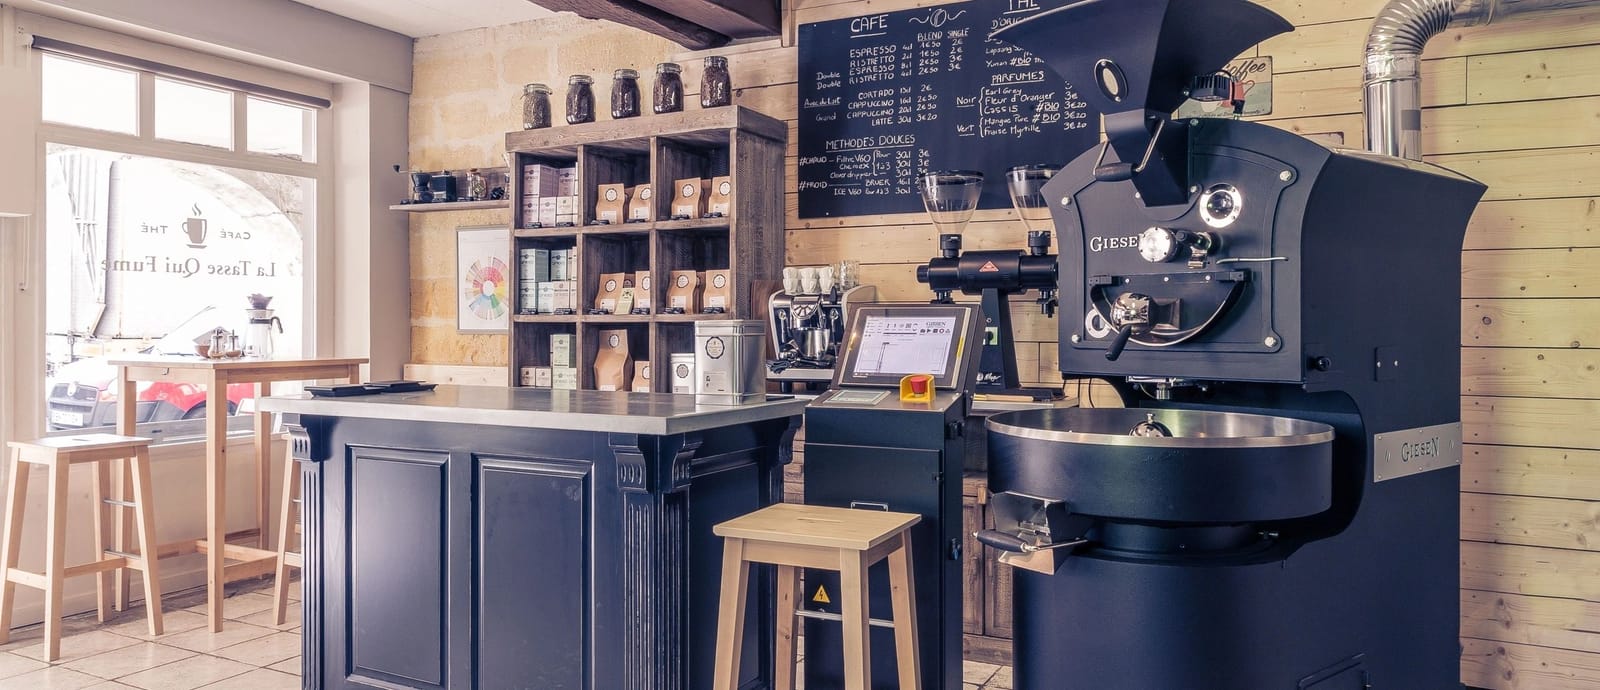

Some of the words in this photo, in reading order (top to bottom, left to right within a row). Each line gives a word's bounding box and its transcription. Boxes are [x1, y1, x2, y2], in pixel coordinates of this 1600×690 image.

[917, 31, 943, 41] BLEND
[947, 28, 968, 38] SINGLE
[850, 45, 896, 58] ESPRESSO
[849, 55, 895, 68] RISTRETTO
[849, 64, 894, 76] ESPRESSO
[949, 55, 962, 63] 3€
[848, 73, 895, 85] RISTRETTO
[948, 63, 961, 71] 3€
[992, 71, 1045, 83] PARFUMES
[858, 89, 894, 100] CORTADO
[921, 84, 932, 92] 2€
[985, 87, 1001, 95] Earl
[1002, 87, 1022, 96] Grey
[848, 100, 894, 110] CAPPUCCINO
[984, 95, 1007, 105] Fleur
[846, 108, 894, 119] CAPPUCCINO
[871, 118, 894, 127] LATTE
[1010, 124, 1041, 138] Myrtille
[826, 137, 874, 150] METHODES
[879, 134, 915, 145] DOUCES
[917, 159, 930, 167] 3€
[1090, 236, 1139, 251] GIESE
[1401, 437, 1440, 462] GIESEN
